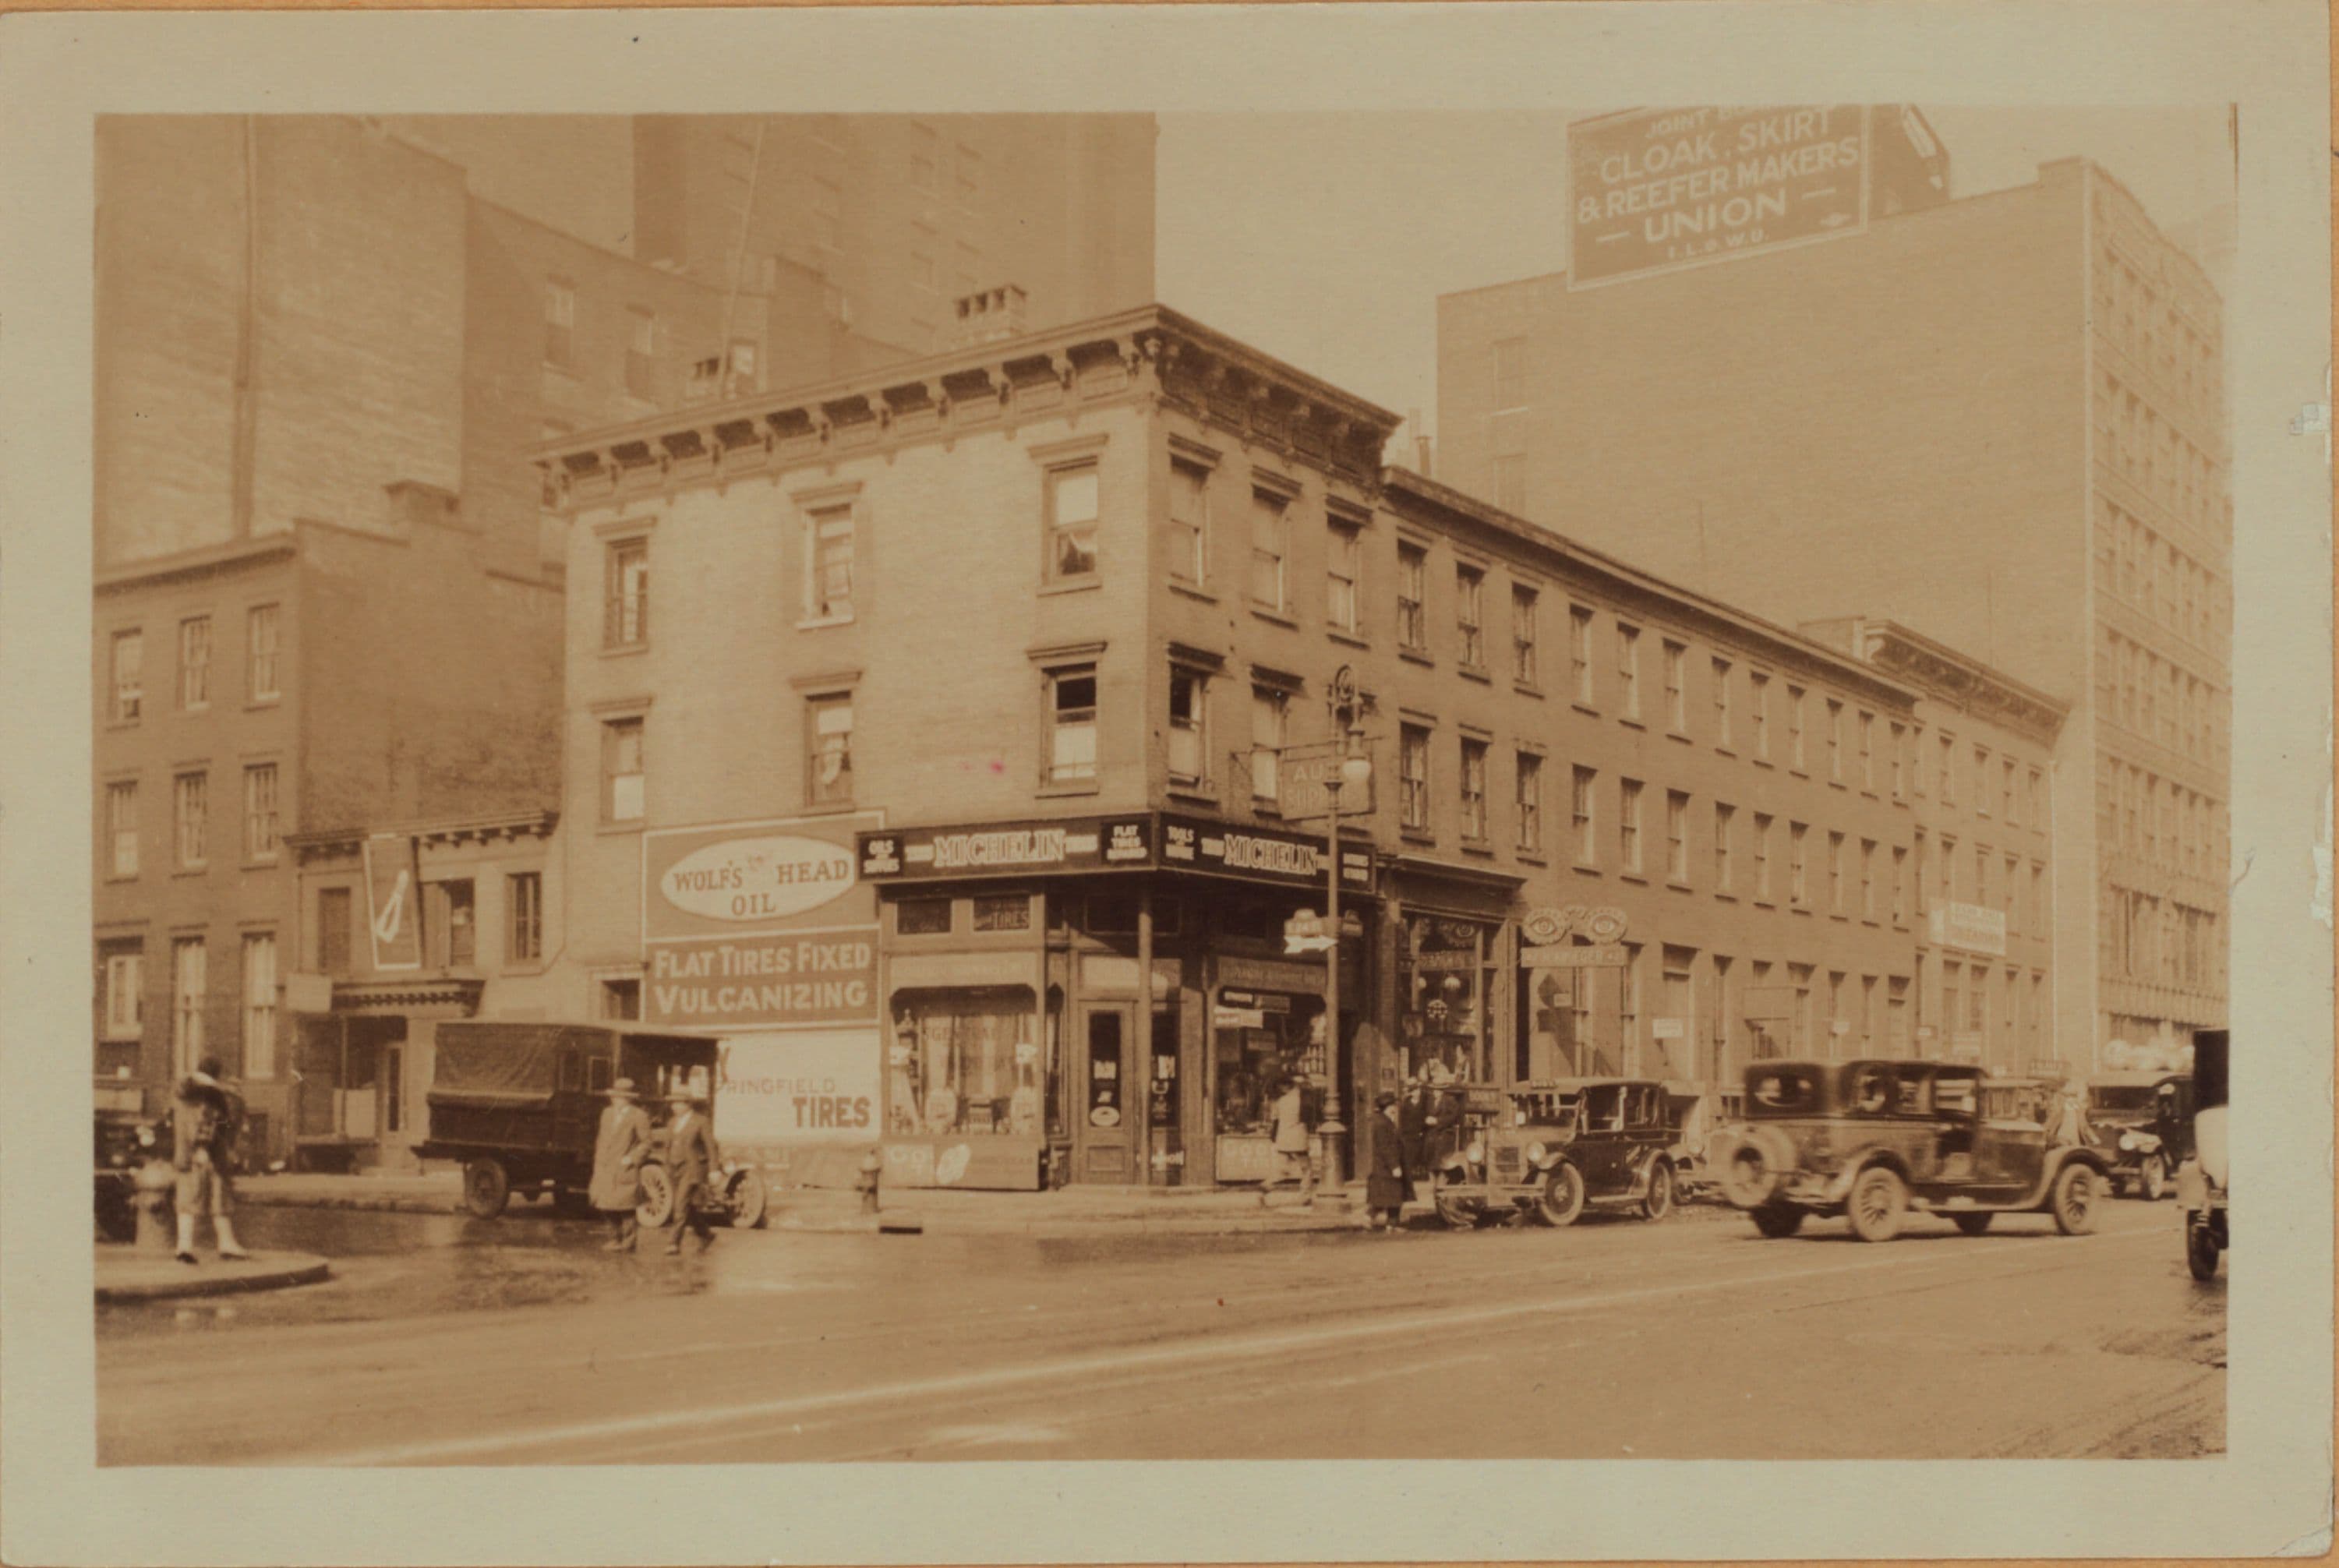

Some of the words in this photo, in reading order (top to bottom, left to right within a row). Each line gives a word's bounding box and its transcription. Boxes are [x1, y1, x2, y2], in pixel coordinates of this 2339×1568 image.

[1644, 108, 1709, 139] JOINT
[1737, 108, 1832, 152] SKIRT
[1577, 196, 1603, 224] &
[1606, 167, 1730, 219] REEFER
[1736, 137, 1860, 189] MAKERS
[1644, 188, 1786, 243] UNION
[934, 829, 1065, 868] MICHELIN
[1224, 833, 1317, 875] MICHELIN
[673, 860, 743, 892] WOLF'S
[776, 860, 849, 885] HEAD
[731, 893, 776, 916] OIL
[654, 948, 717, 977] FLAT
[719, 945, 791, 976] TIRES
[797, 941, 871, 973] FIXED
[654, 981, 867, 1014] VULCANIZING
[792, 1096, 871, 1128] TIRES
